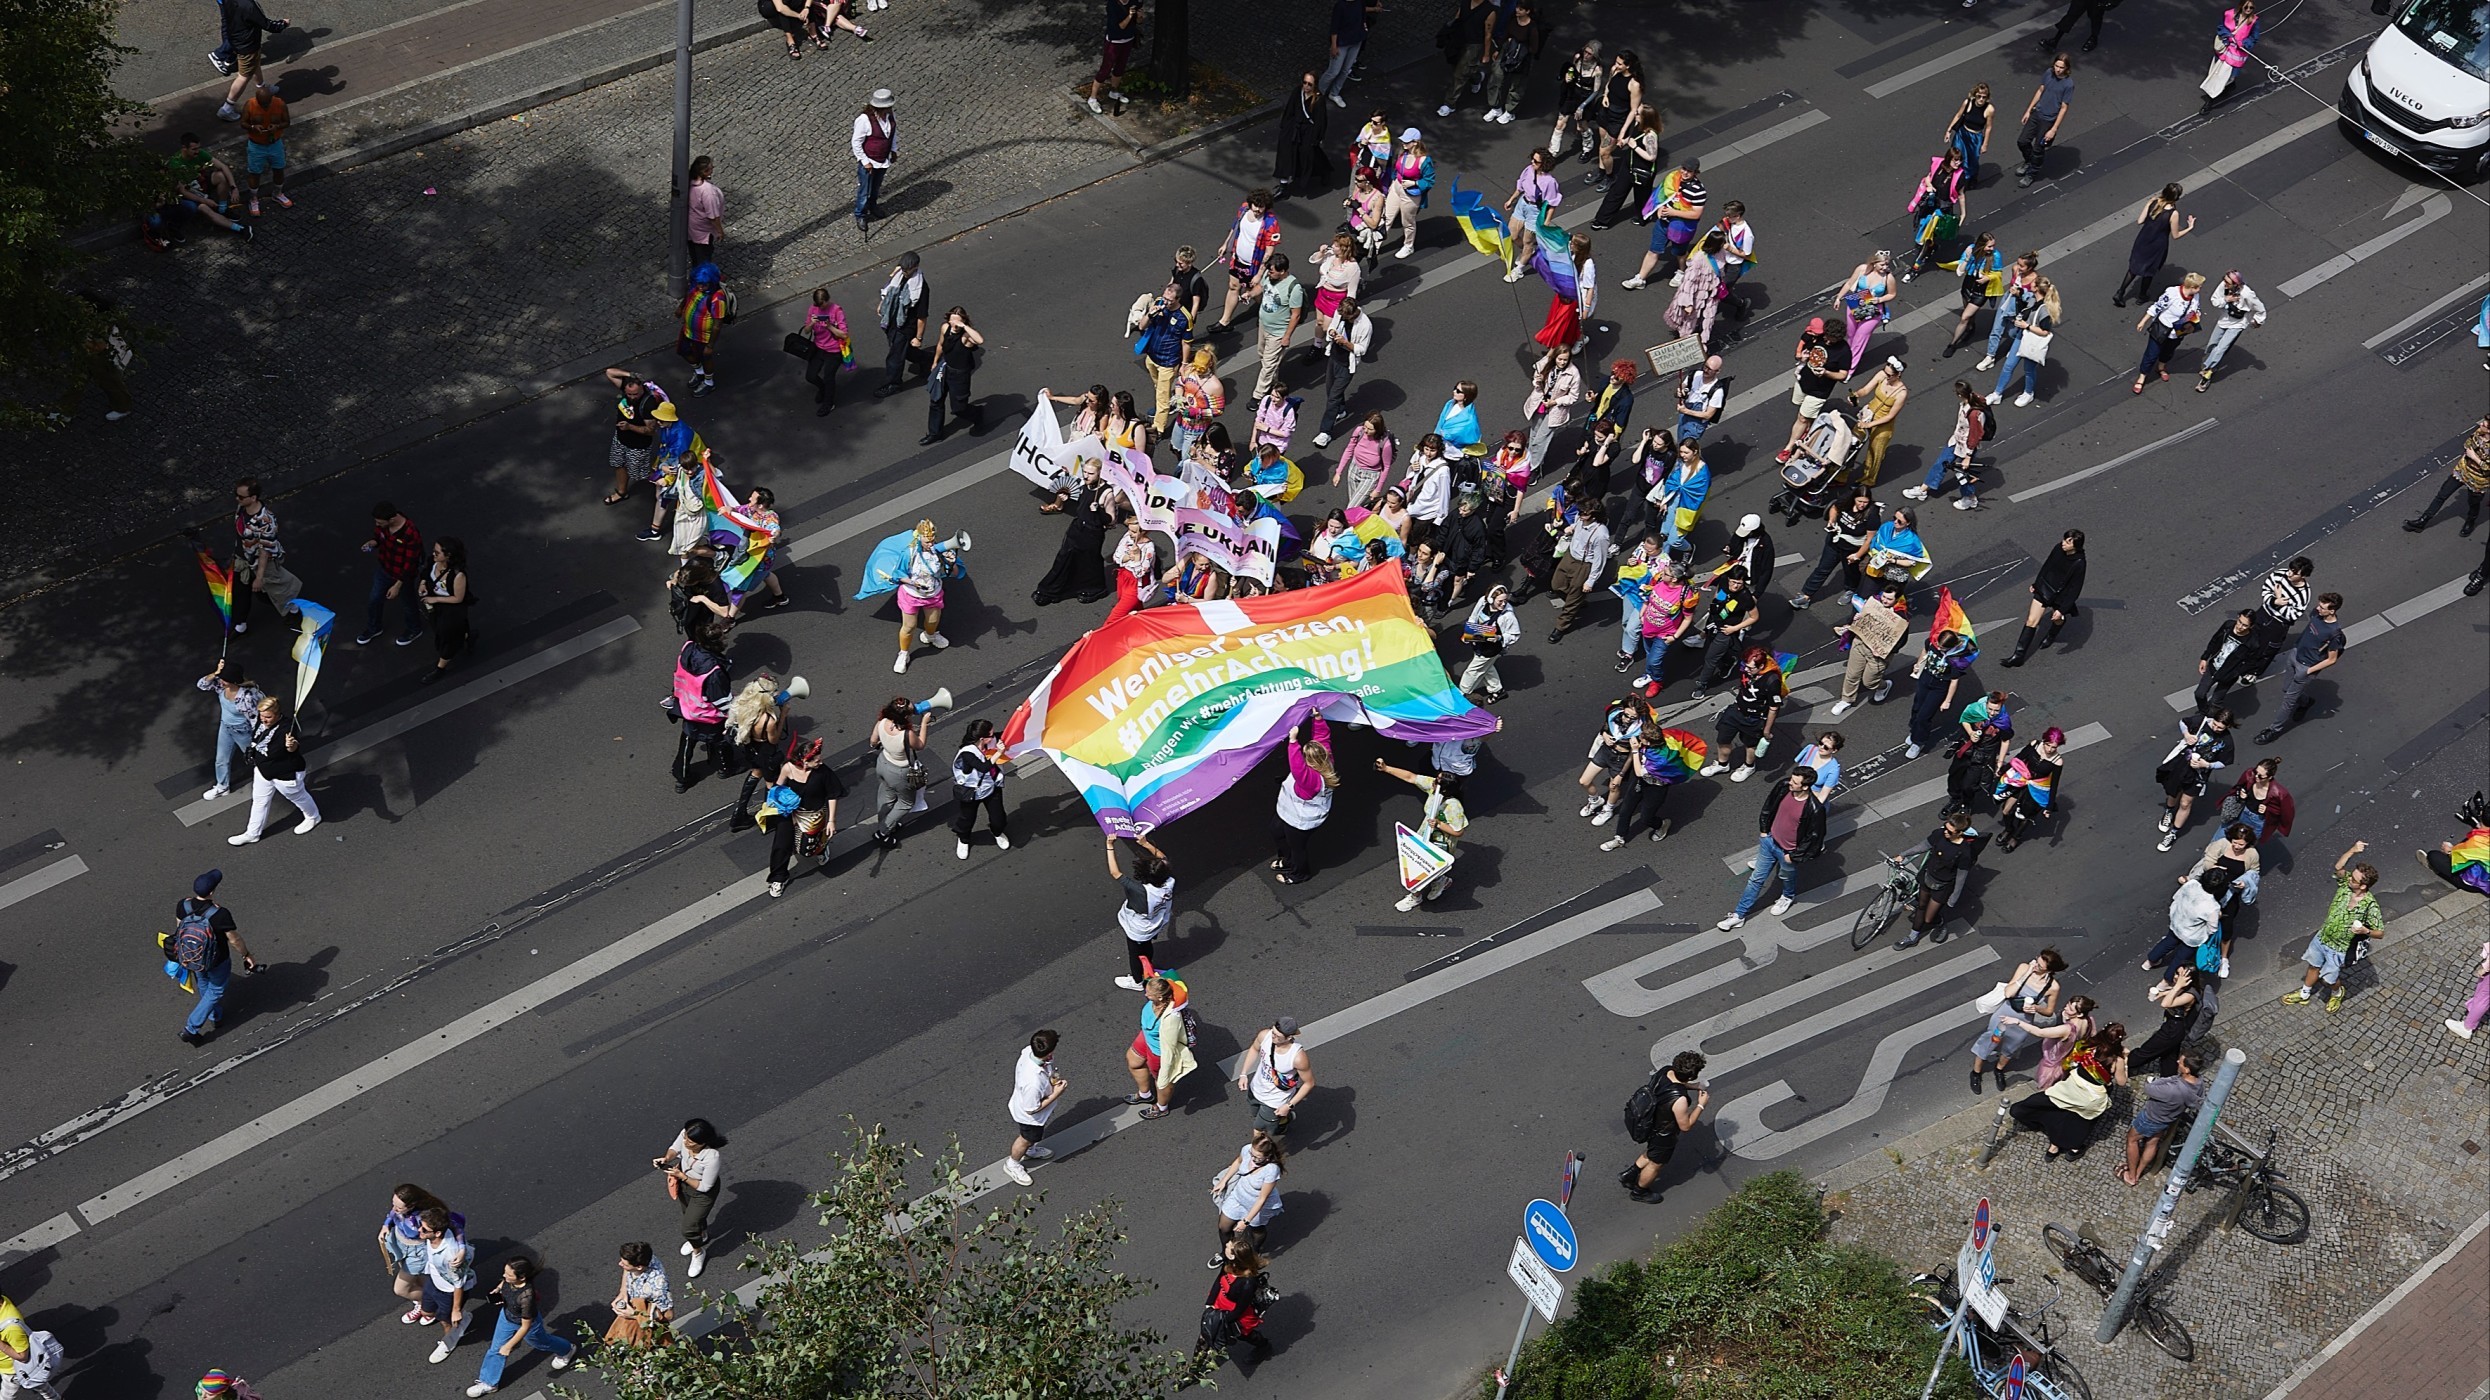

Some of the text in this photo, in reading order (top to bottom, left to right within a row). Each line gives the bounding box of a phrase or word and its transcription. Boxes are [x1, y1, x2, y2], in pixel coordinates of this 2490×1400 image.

[2389, 87, 2423, 111] IVECO
[1655, 349, 1683, 364] STAND
[1659, 352, 1699, 370] UKRAINE
[1140, 730, 1184, 770] Bringen
[1200, 678, 1303, 719] #mehrAchtung
